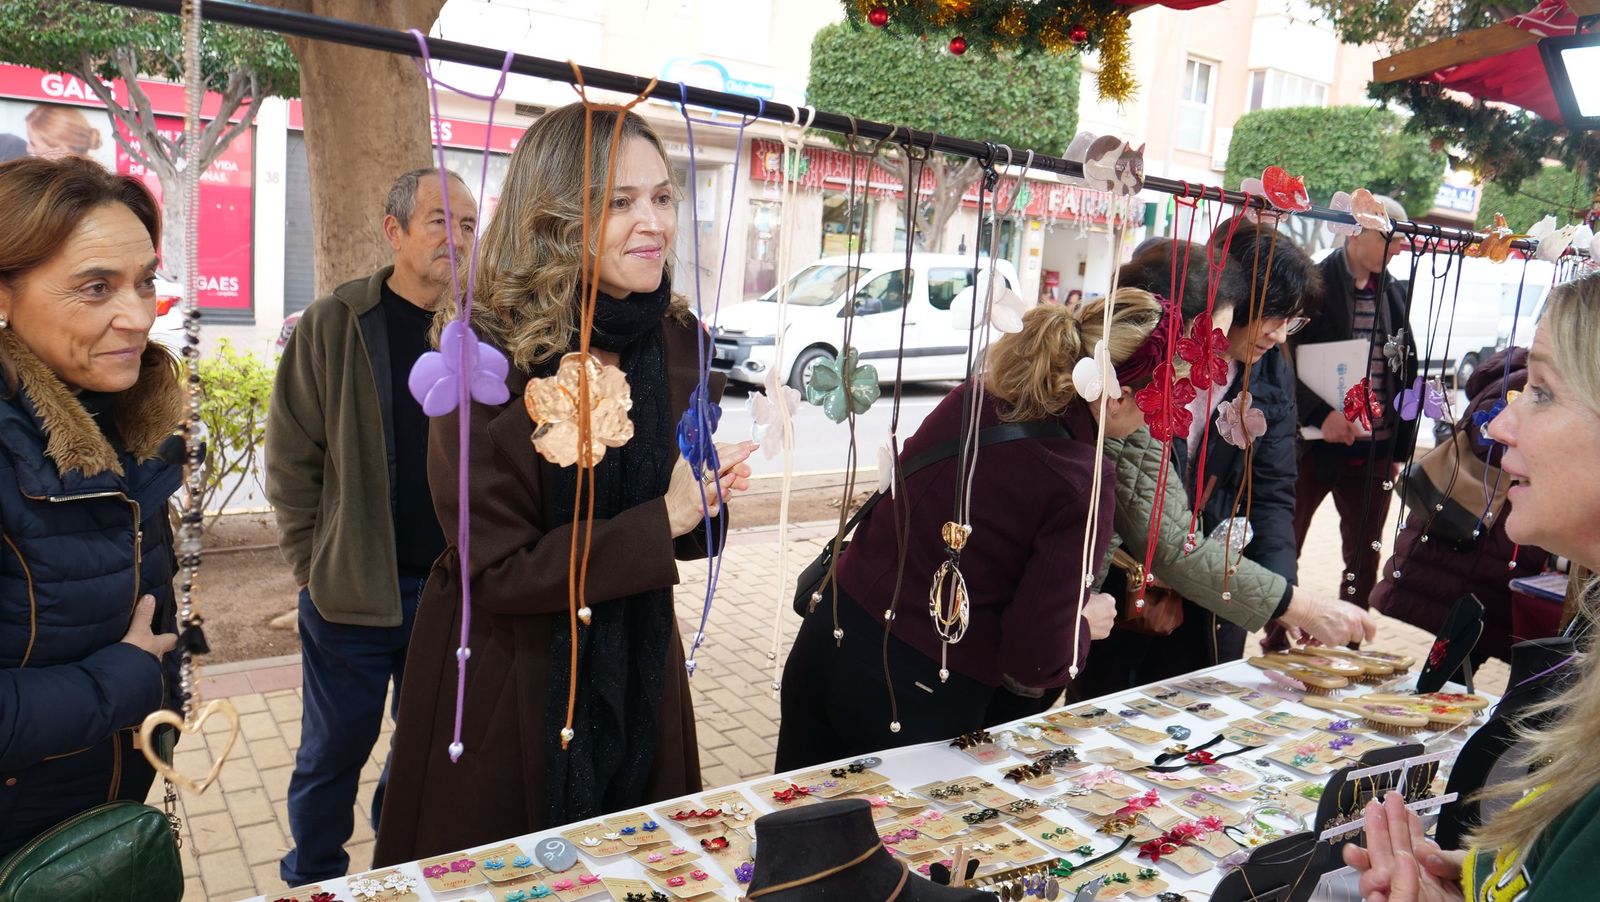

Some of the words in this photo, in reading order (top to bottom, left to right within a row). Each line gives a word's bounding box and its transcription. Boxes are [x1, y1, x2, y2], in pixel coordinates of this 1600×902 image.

[430, 120, 452, 141] ES
[213, 160, 238, 171] VIDA
[265, 171, 280, 184] 38
[198, 275, 239, 292] GAES
